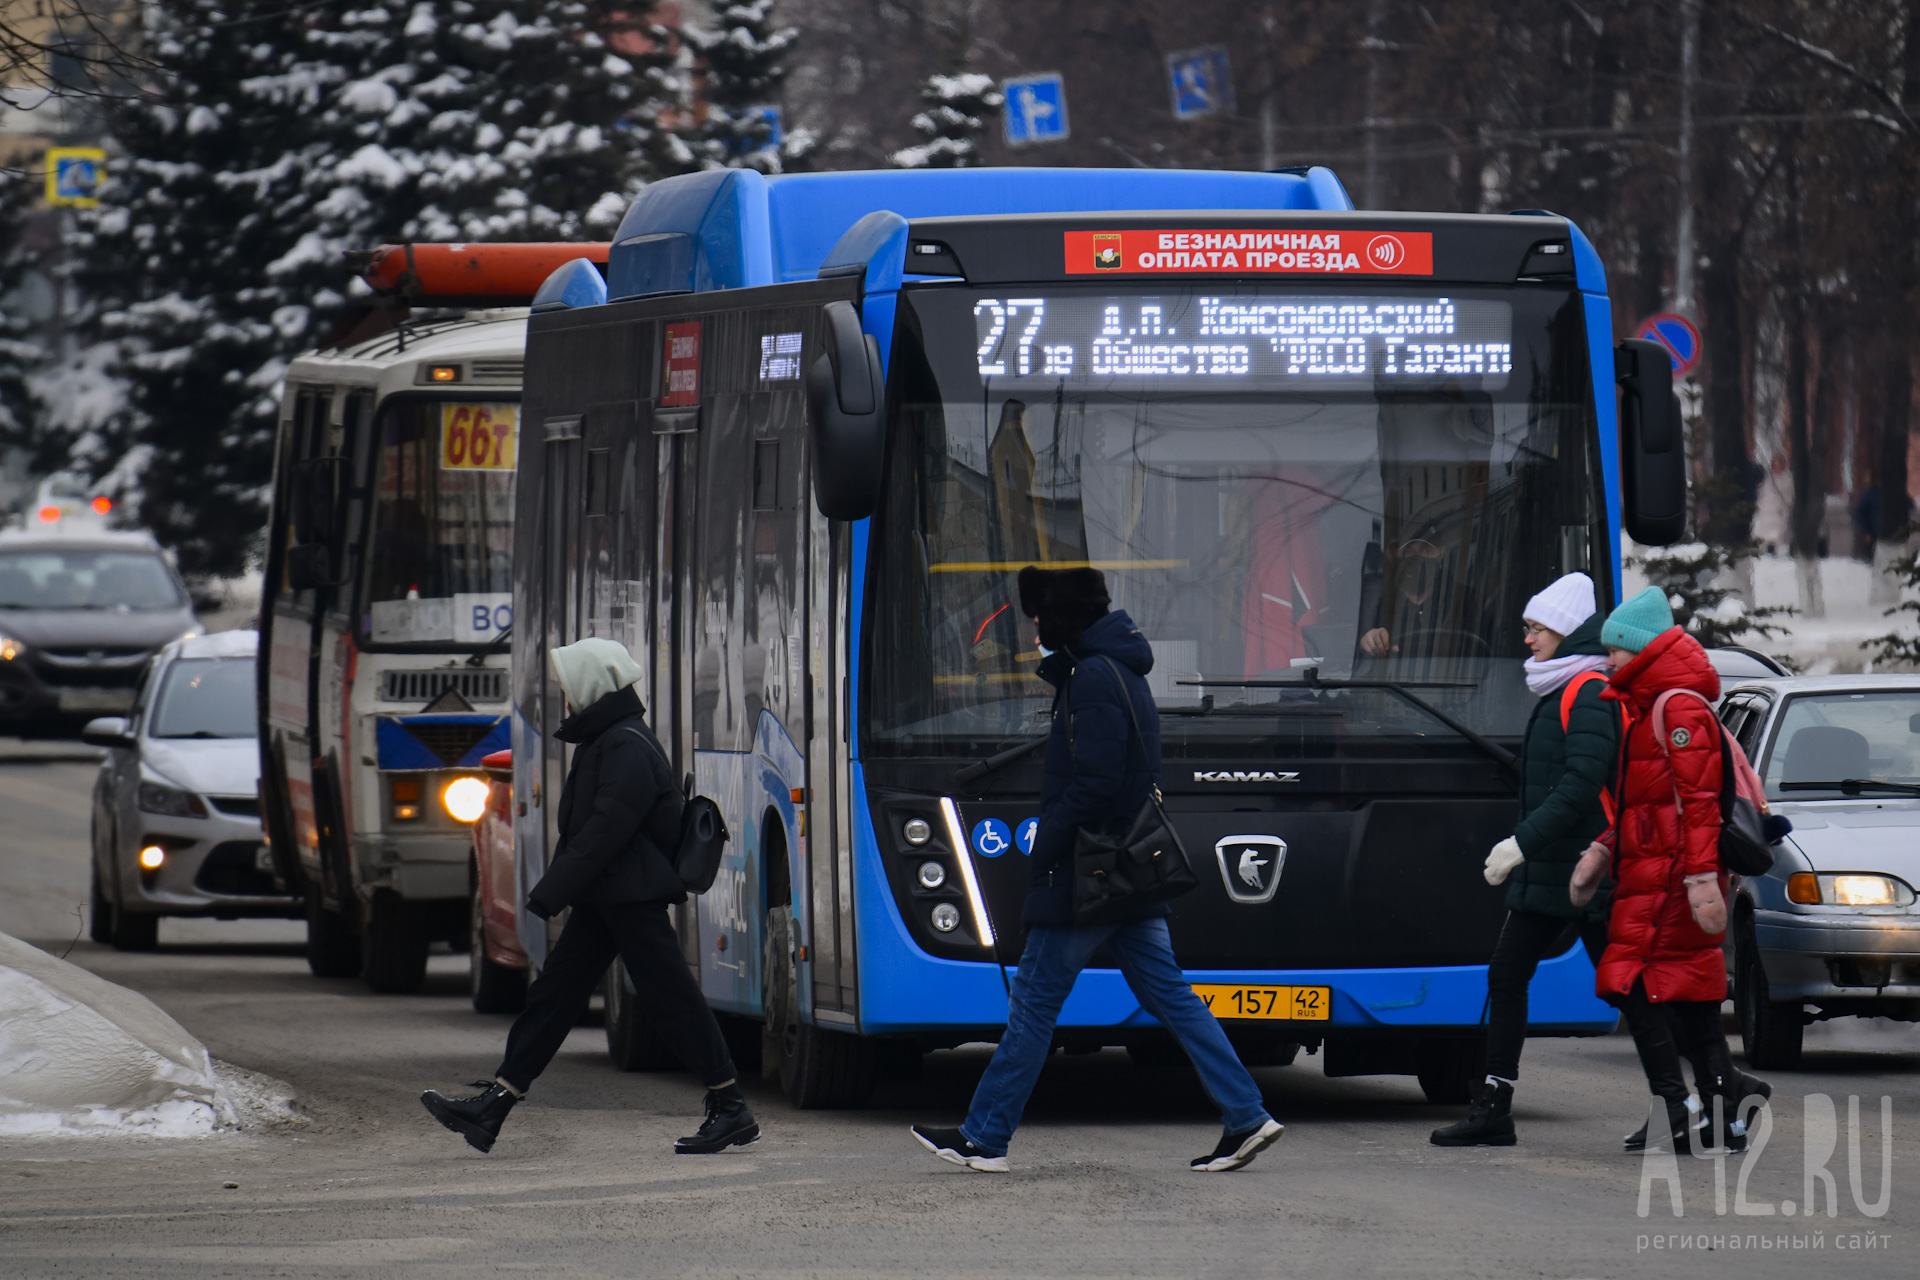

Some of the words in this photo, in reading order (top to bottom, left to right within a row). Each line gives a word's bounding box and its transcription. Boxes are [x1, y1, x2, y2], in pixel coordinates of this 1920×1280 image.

[1158, 232, 1341, 251] БЕЗНАЛИЧНАЯ
[1138, 251, 1239, 270] ОПЛАТА
[1246, 251, 1361, 271] ПРОЕЗДА
[1199, 297, 1455, 335] Комсомольский
[973, 298, 1044, 376] 27
[1092, 338, 1249, 375] Общество
[1193, 771, 1301, 783] KAMAZ
[1231, 989, 1278, 1014] 157
[1295, 990, 1320, 1009] 42
[1297, 1009, 1317, 1017] RUS
